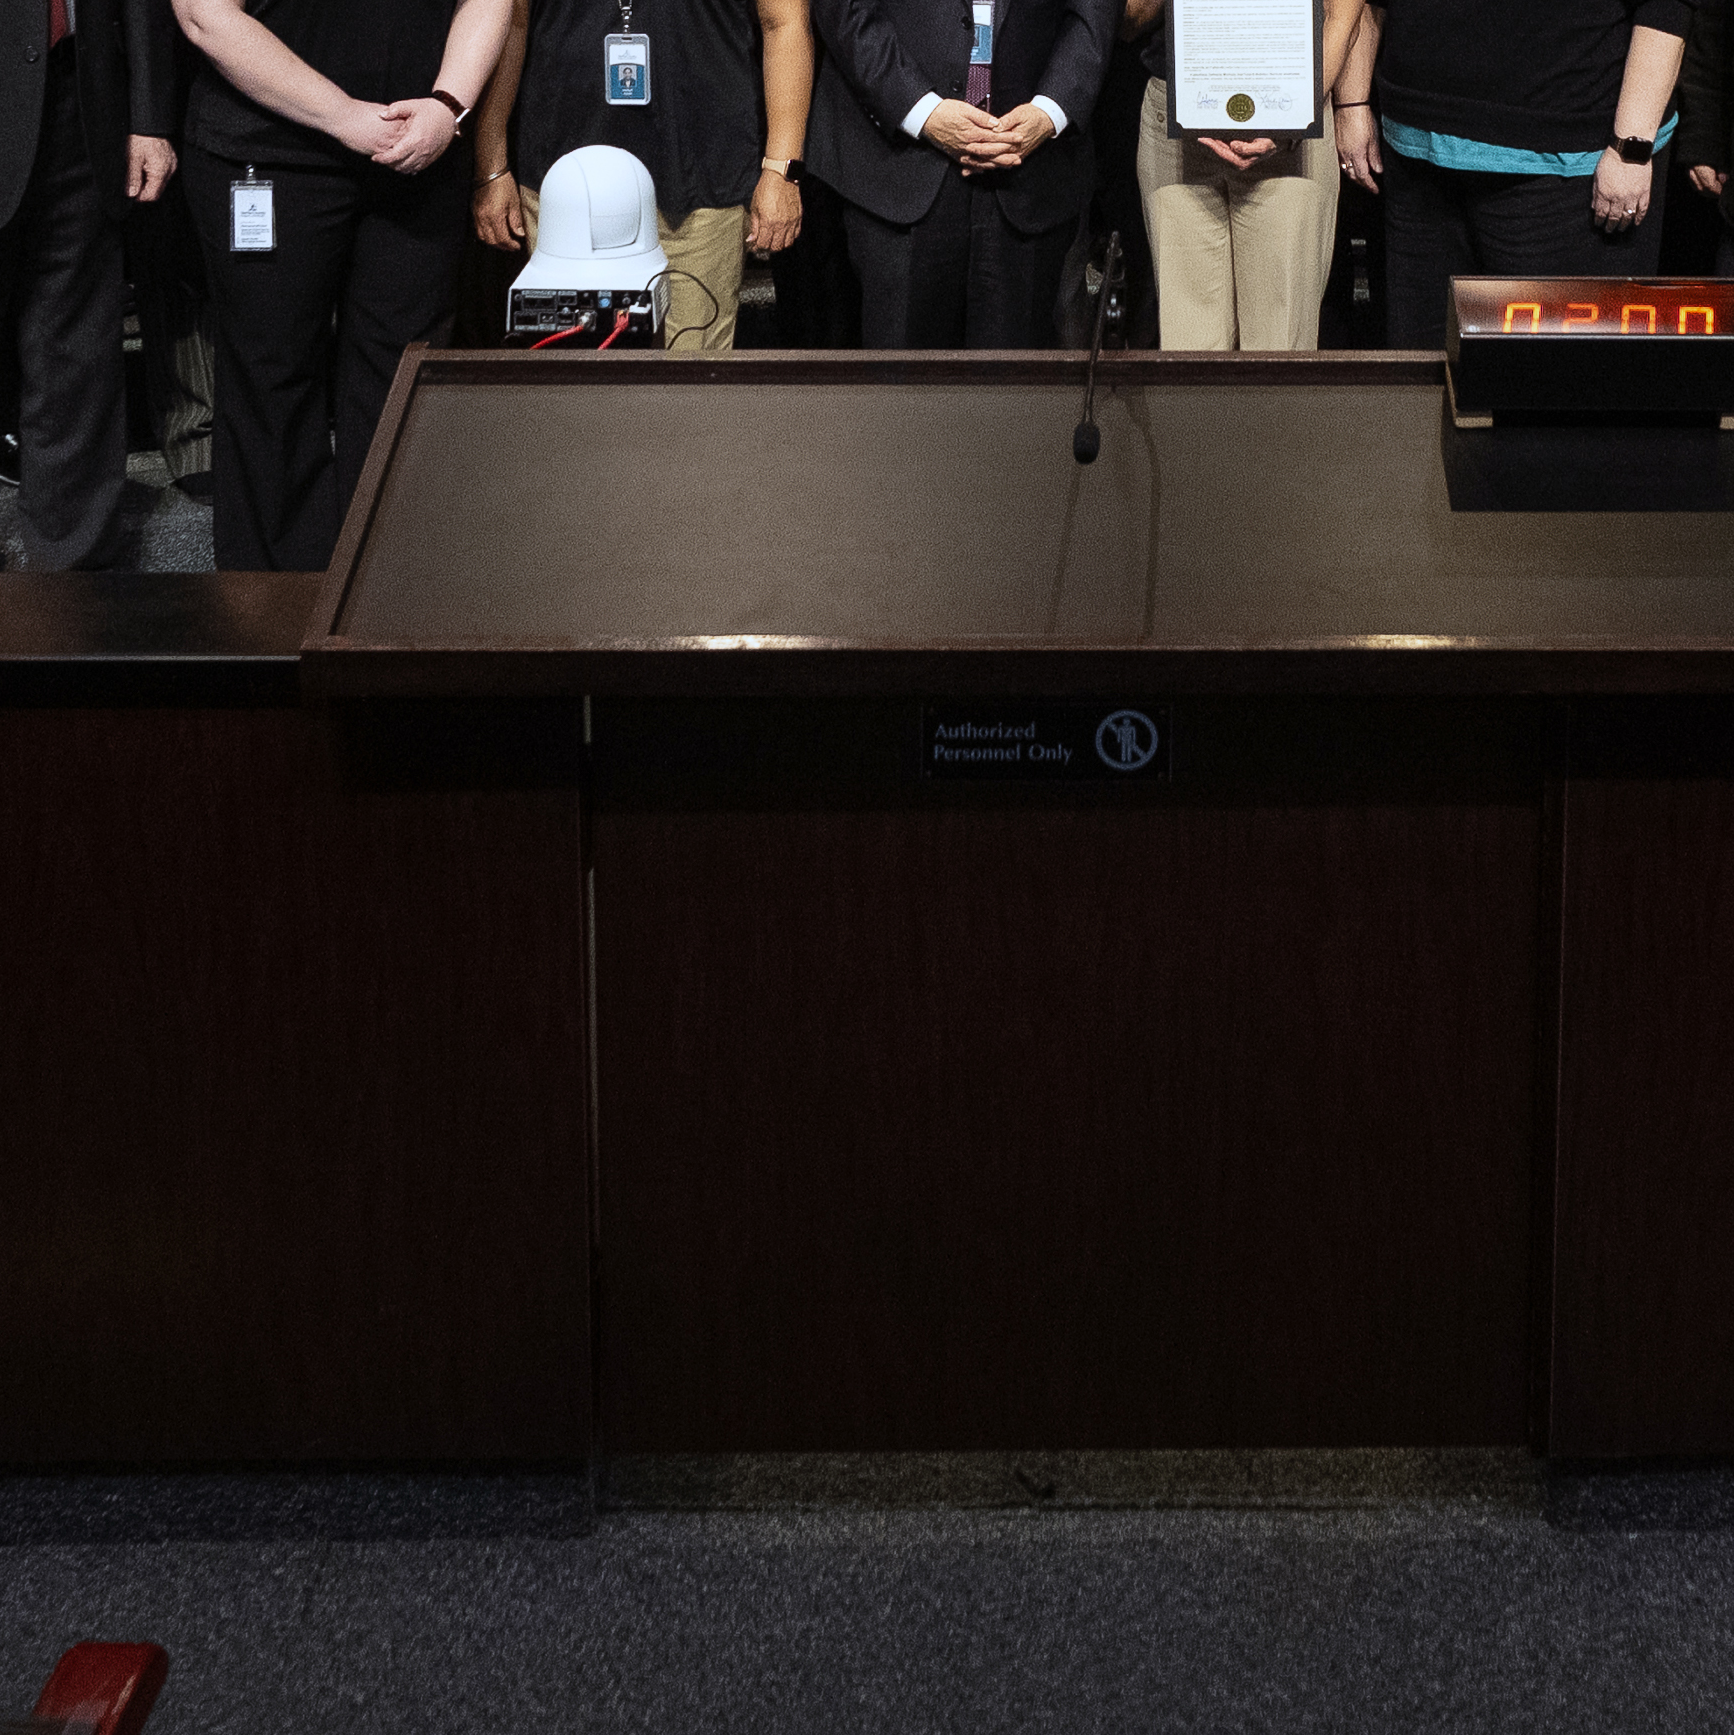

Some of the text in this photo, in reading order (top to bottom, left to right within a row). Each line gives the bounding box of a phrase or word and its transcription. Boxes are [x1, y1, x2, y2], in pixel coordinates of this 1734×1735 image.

[934, 720, 1036, 740] Authorized
[933, 743, 1073, 765] Personnel Only
